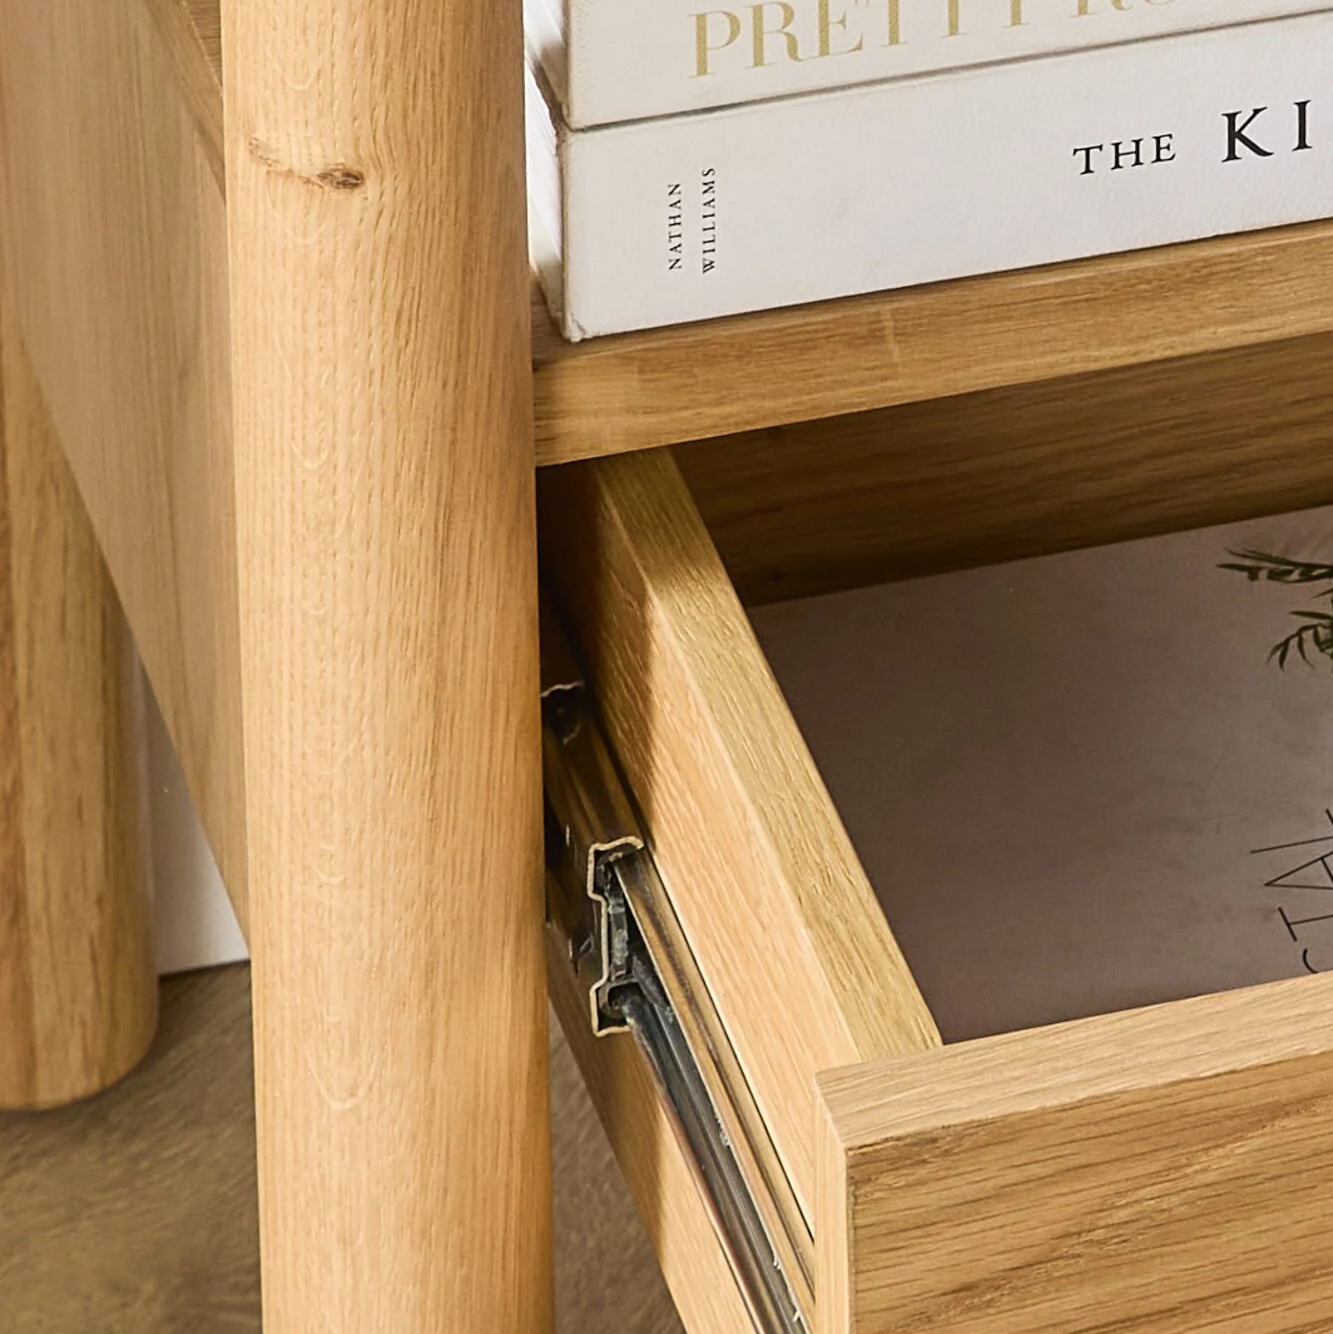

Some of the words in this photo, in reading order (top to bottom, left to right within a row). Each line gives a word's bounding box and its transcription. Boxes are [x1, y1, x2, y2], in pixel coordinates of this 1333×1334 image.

[1073, 133, 1177, 176] THE
[668, 183, 683, 271] NATHAN
[701, 168, 716, 275] WILLIAMS
